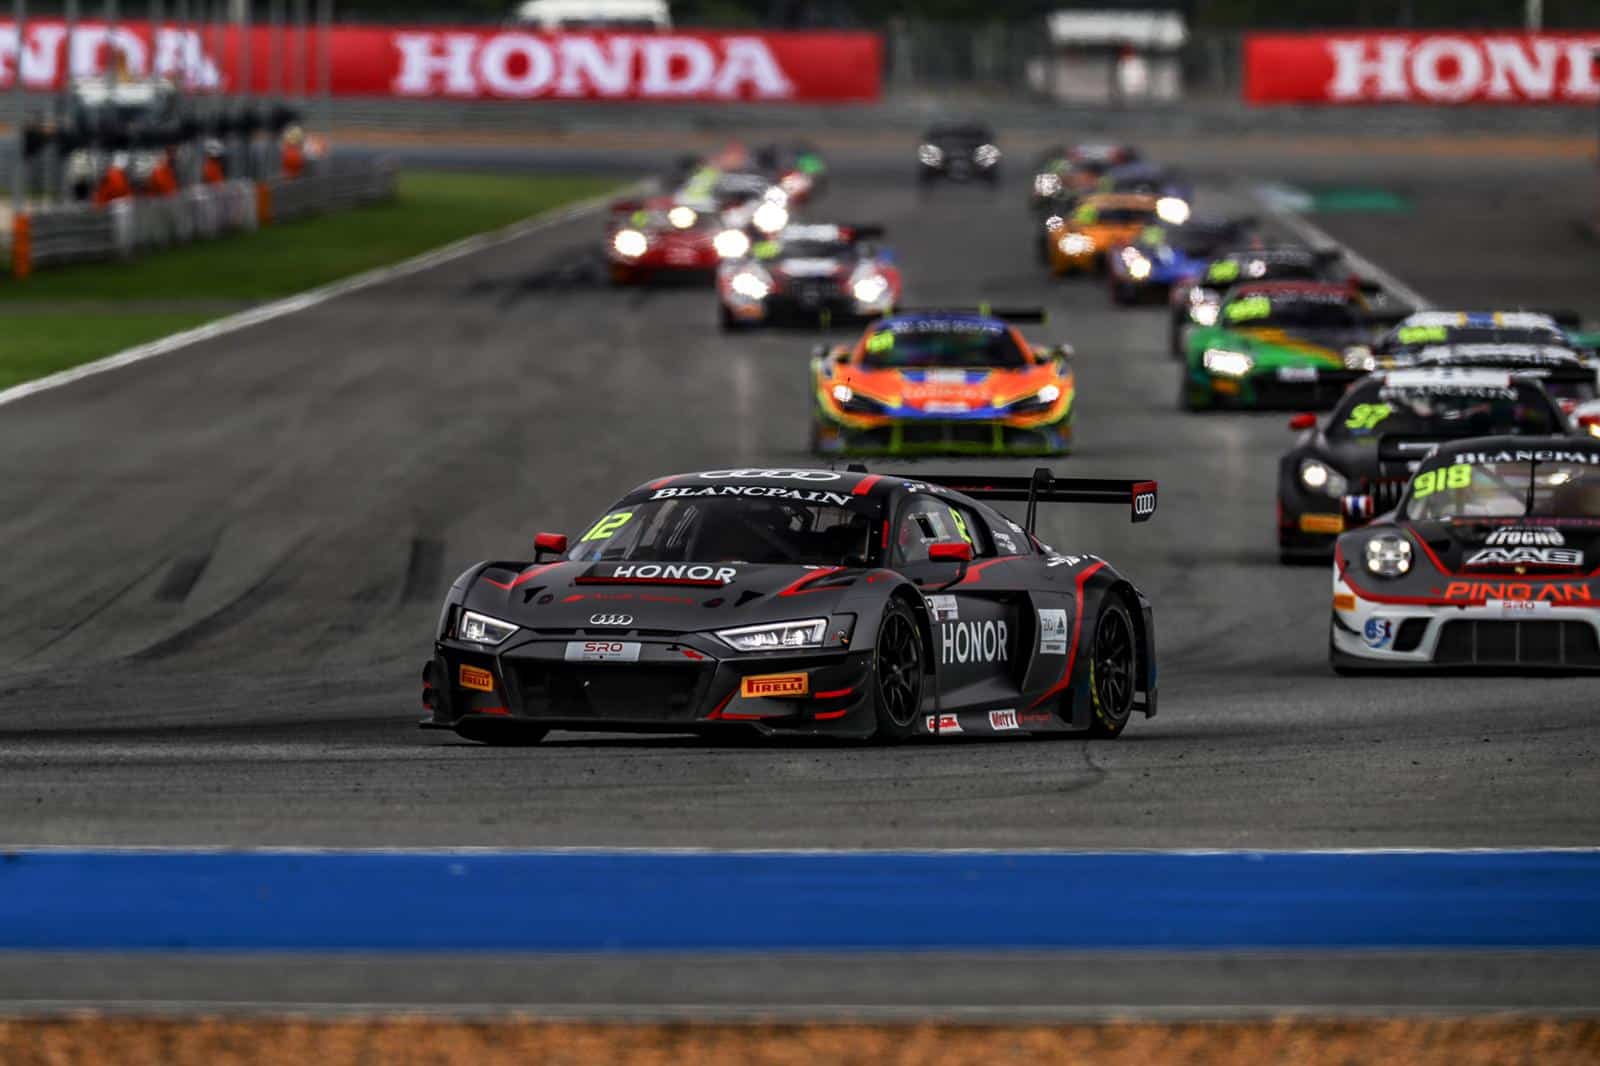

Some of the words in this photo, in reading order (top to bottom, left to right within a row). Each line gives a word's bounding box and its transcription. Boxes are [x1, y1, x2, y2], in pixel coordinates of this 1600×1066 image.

[393, 33, 795, 98] HONDA
[1413, 464, 1472, 499] 918
[650, 486, 853, 506] BLANCPAIN
[580, 512, 633, 543] 12
[612, 565, 737, 584] HONOR
[583, 642, 624, 653] SRO
[941, 620, 1008, 664] HONOR
[747, 677, 803, 693] PIRELLI
